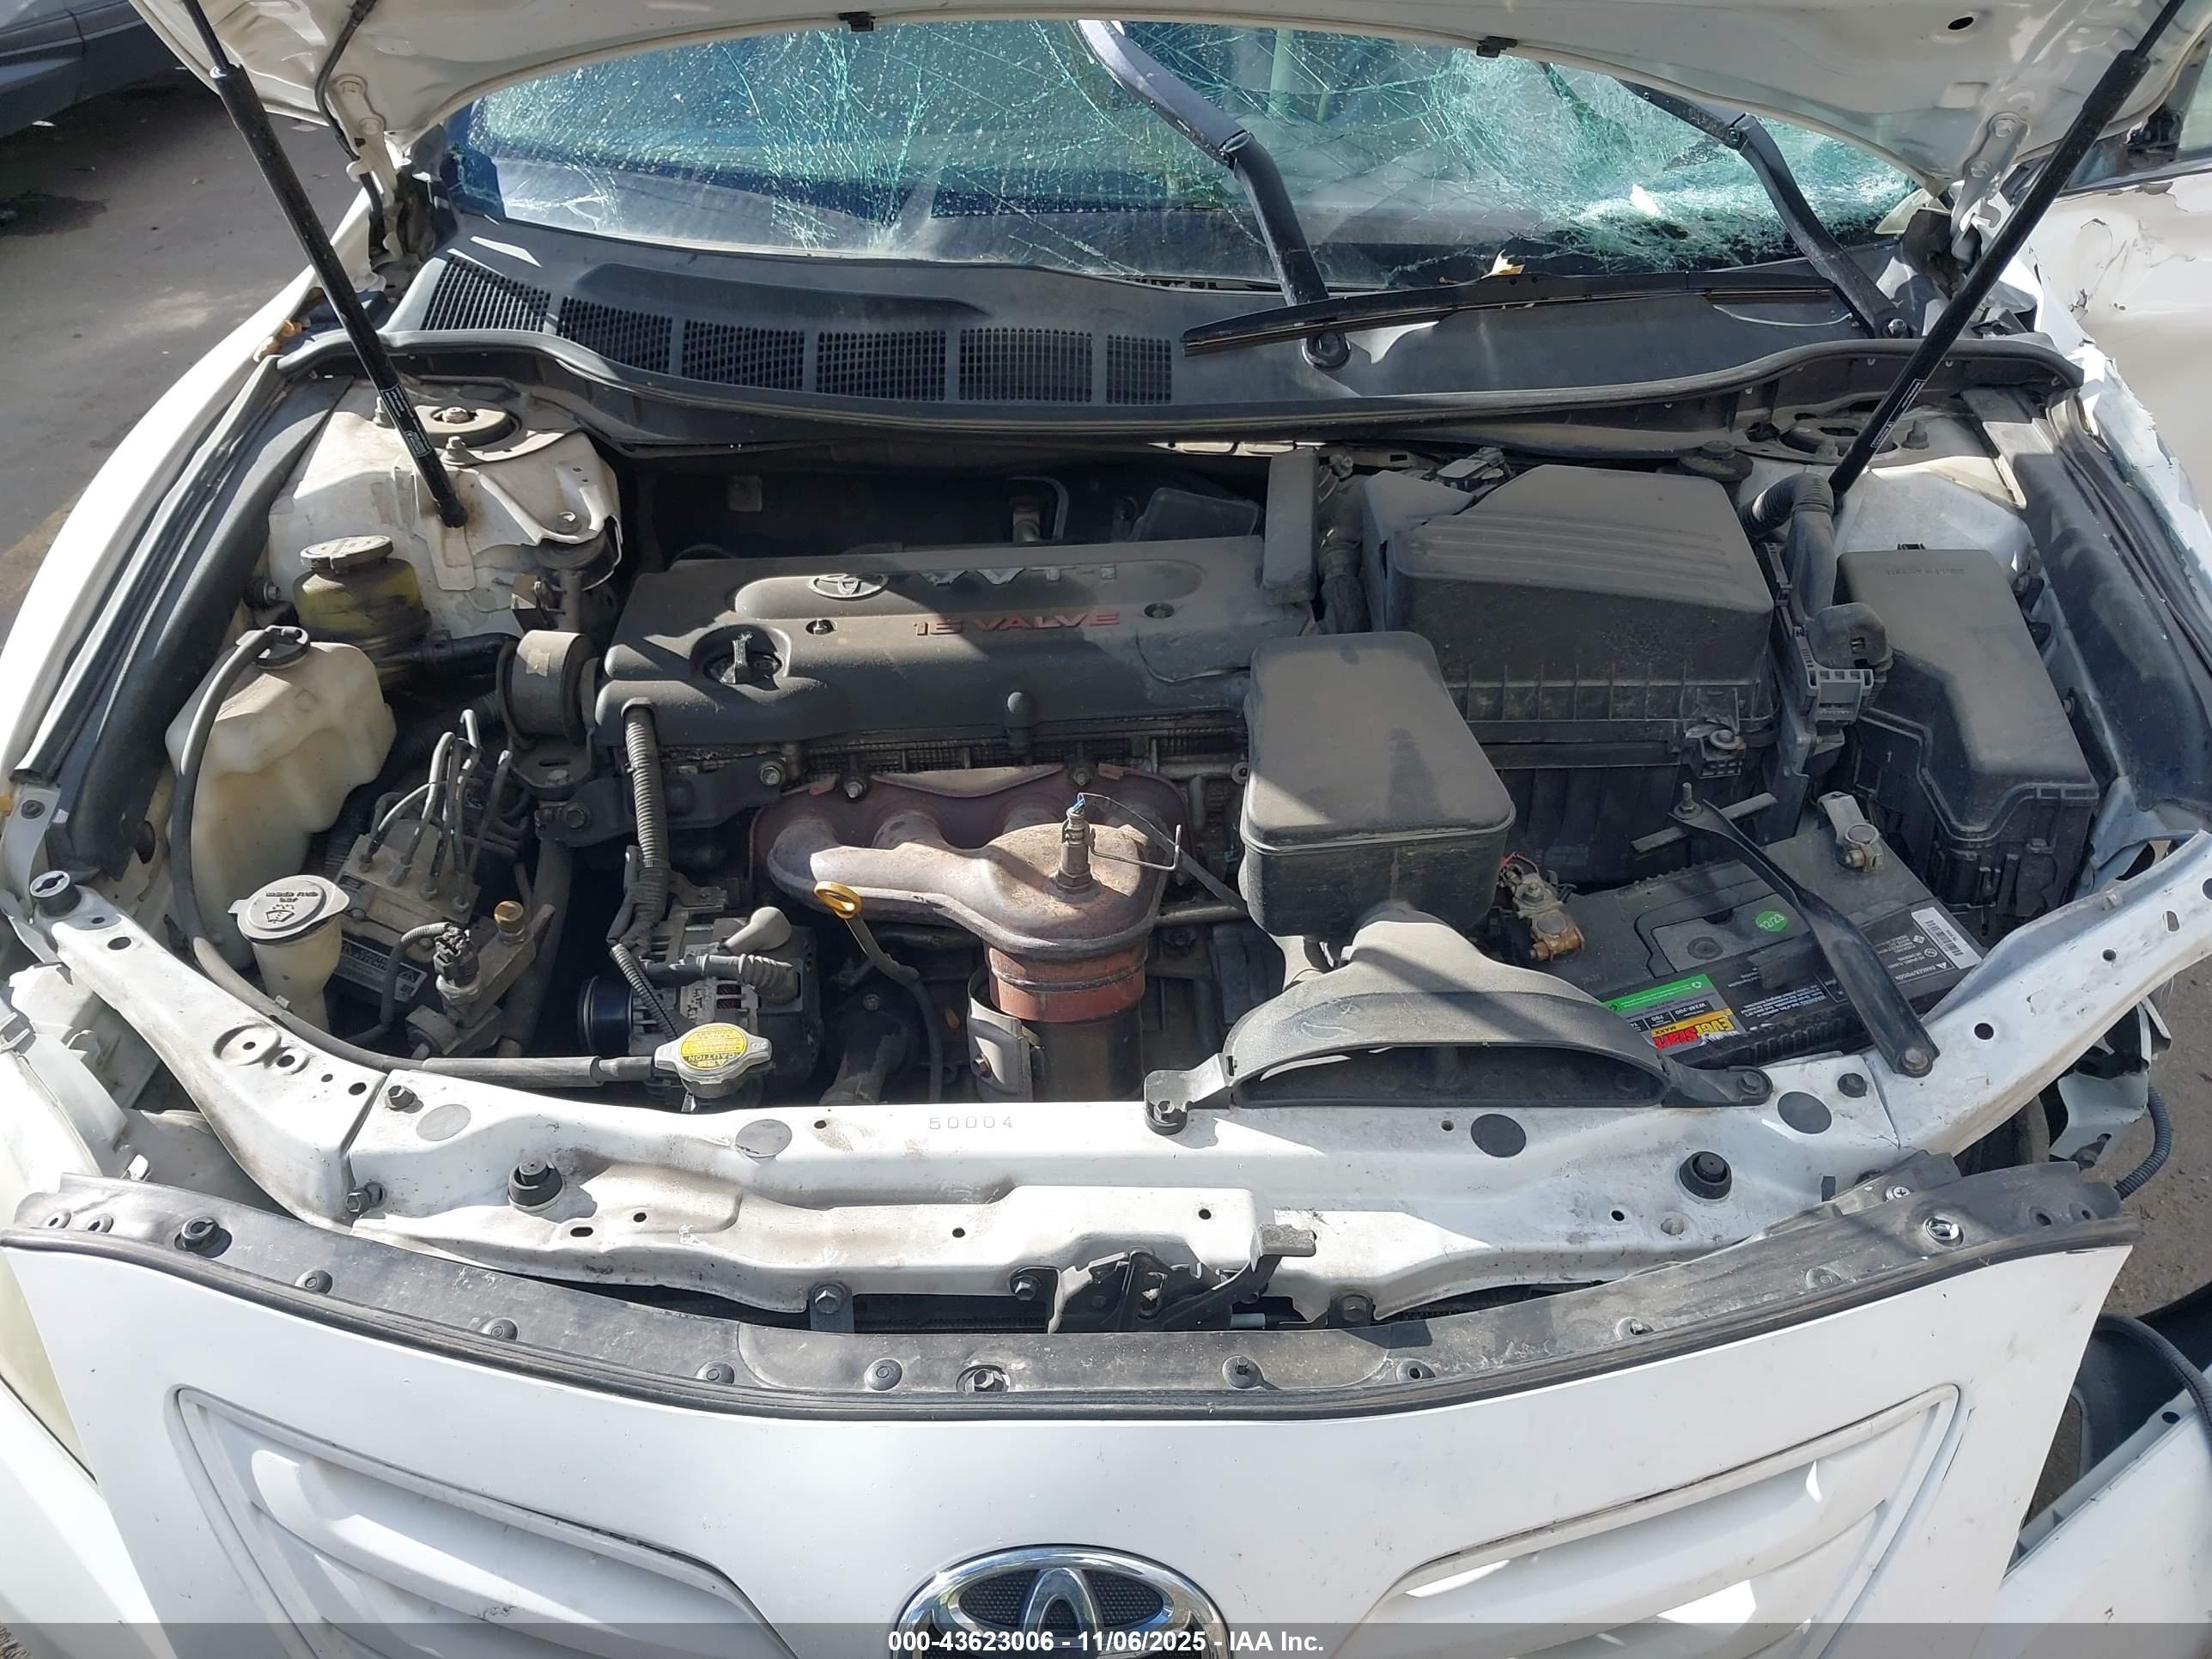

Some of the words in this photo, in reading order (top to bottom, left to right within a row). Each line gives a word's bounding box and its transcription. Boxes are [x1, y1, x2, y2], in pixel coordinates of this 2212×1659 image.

[912, 618, 963, 636] 16
[974, 611, 1121, 631] VALVE
[1758, 913, 1785, 930] 12/23
[1654, 1024, 1677, 1036] MAXX
[688, 1053, 736, 1061] CAUTION
[928, 1115, 1014, 1131] 50004
